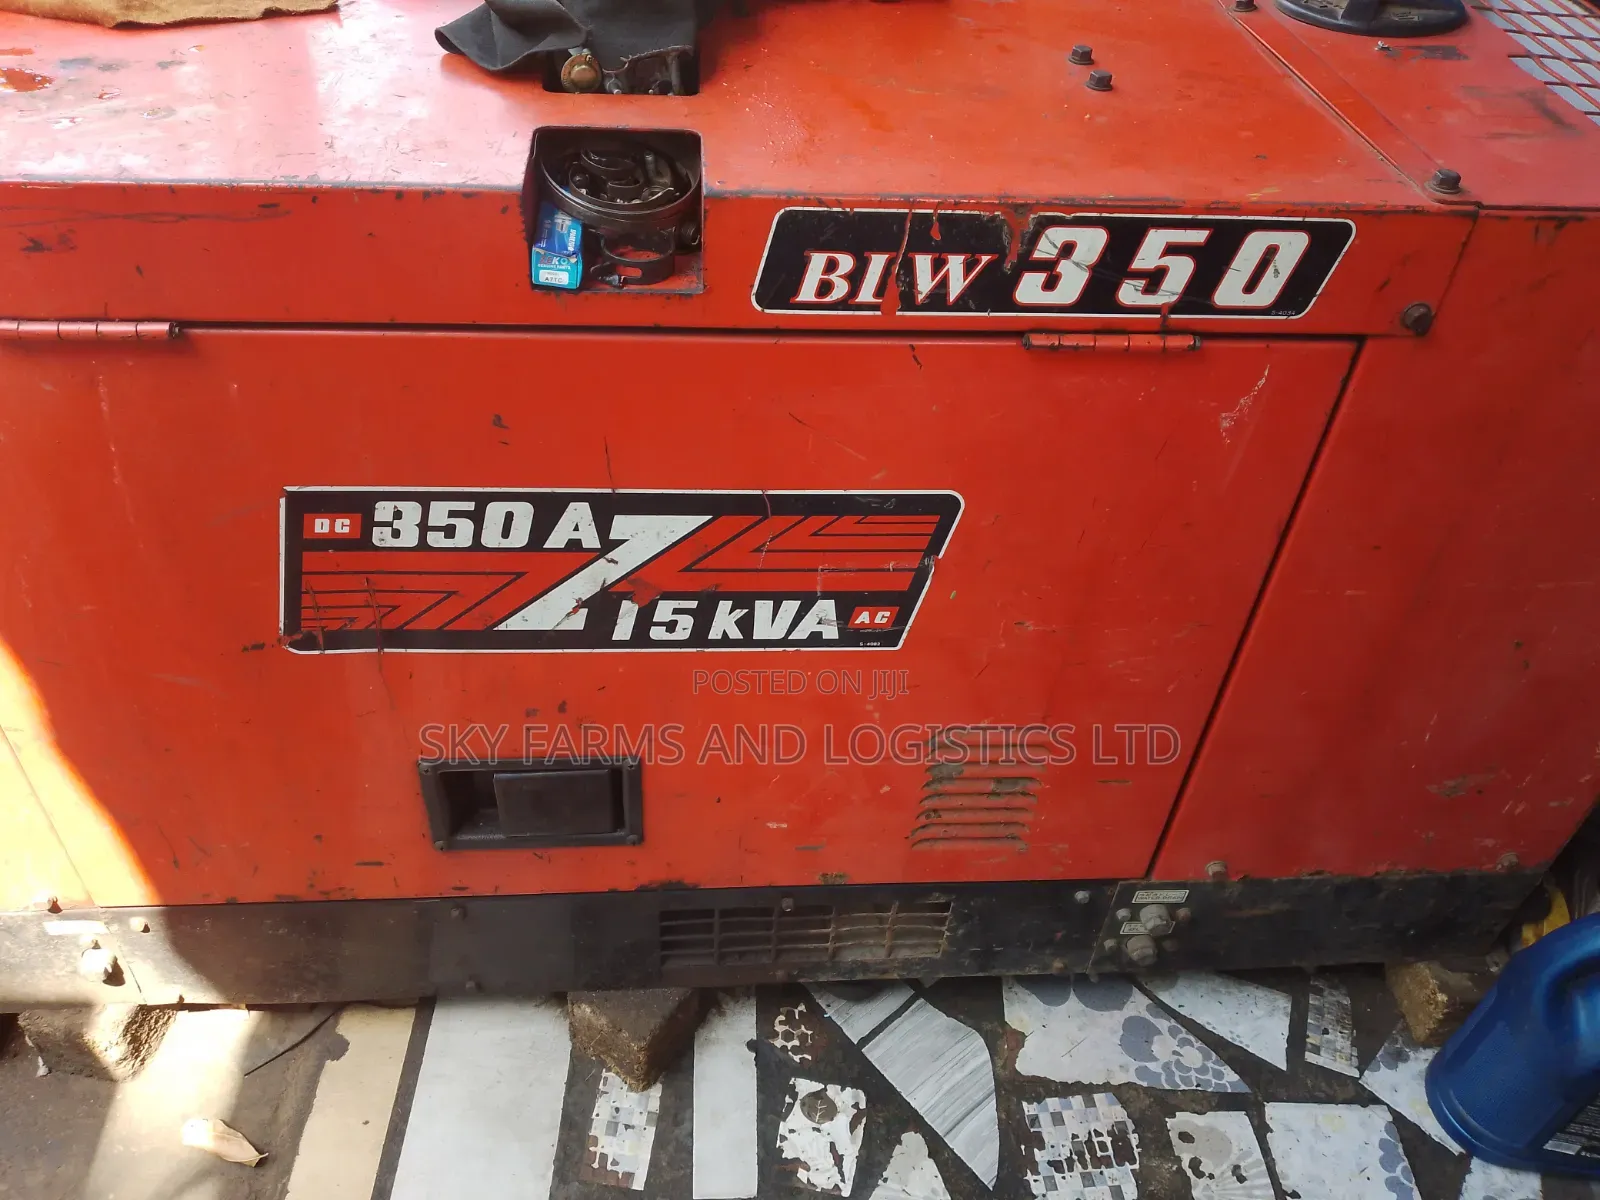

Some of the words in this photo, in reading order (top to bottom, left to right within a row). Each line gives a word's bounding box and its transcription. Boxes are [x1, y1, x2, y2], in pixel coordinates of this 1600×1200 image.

[1013, 225, 1311, 309] 350
[314, 518, 351, 534] DC
[371, 501, 535, 548] 350
[707, 600, 840, 640] kVA
[854, 611, 891, 624] AC
